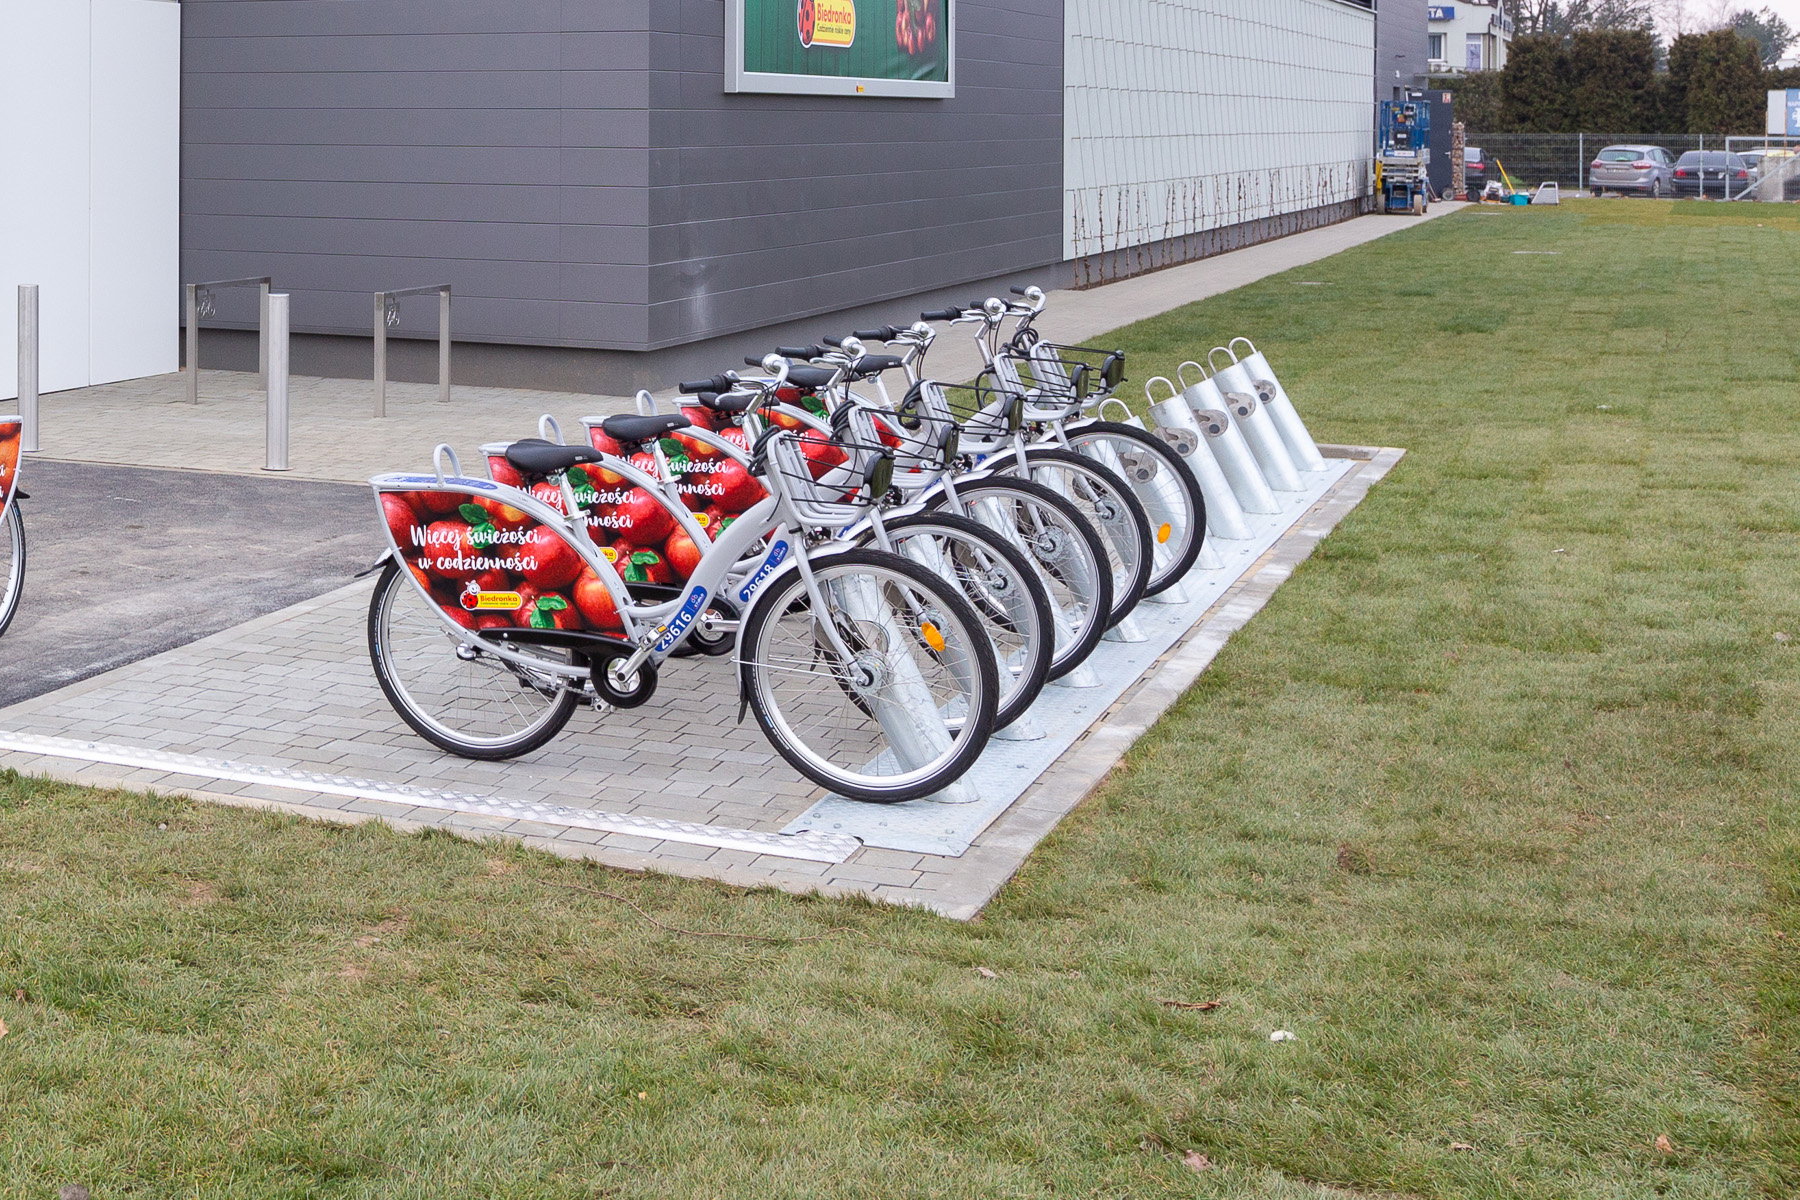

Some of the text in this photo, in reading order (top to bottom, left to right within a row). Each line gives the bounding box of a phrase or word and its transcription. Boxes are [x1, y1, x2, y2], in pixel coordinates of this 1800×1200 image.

[817, 3, 852, 25] Biedronka
[410, 525, 542, 550] Więcej świeżości
[418, 550, 539, 571] w codzienności
[661, 610, 692, 650] 29616
